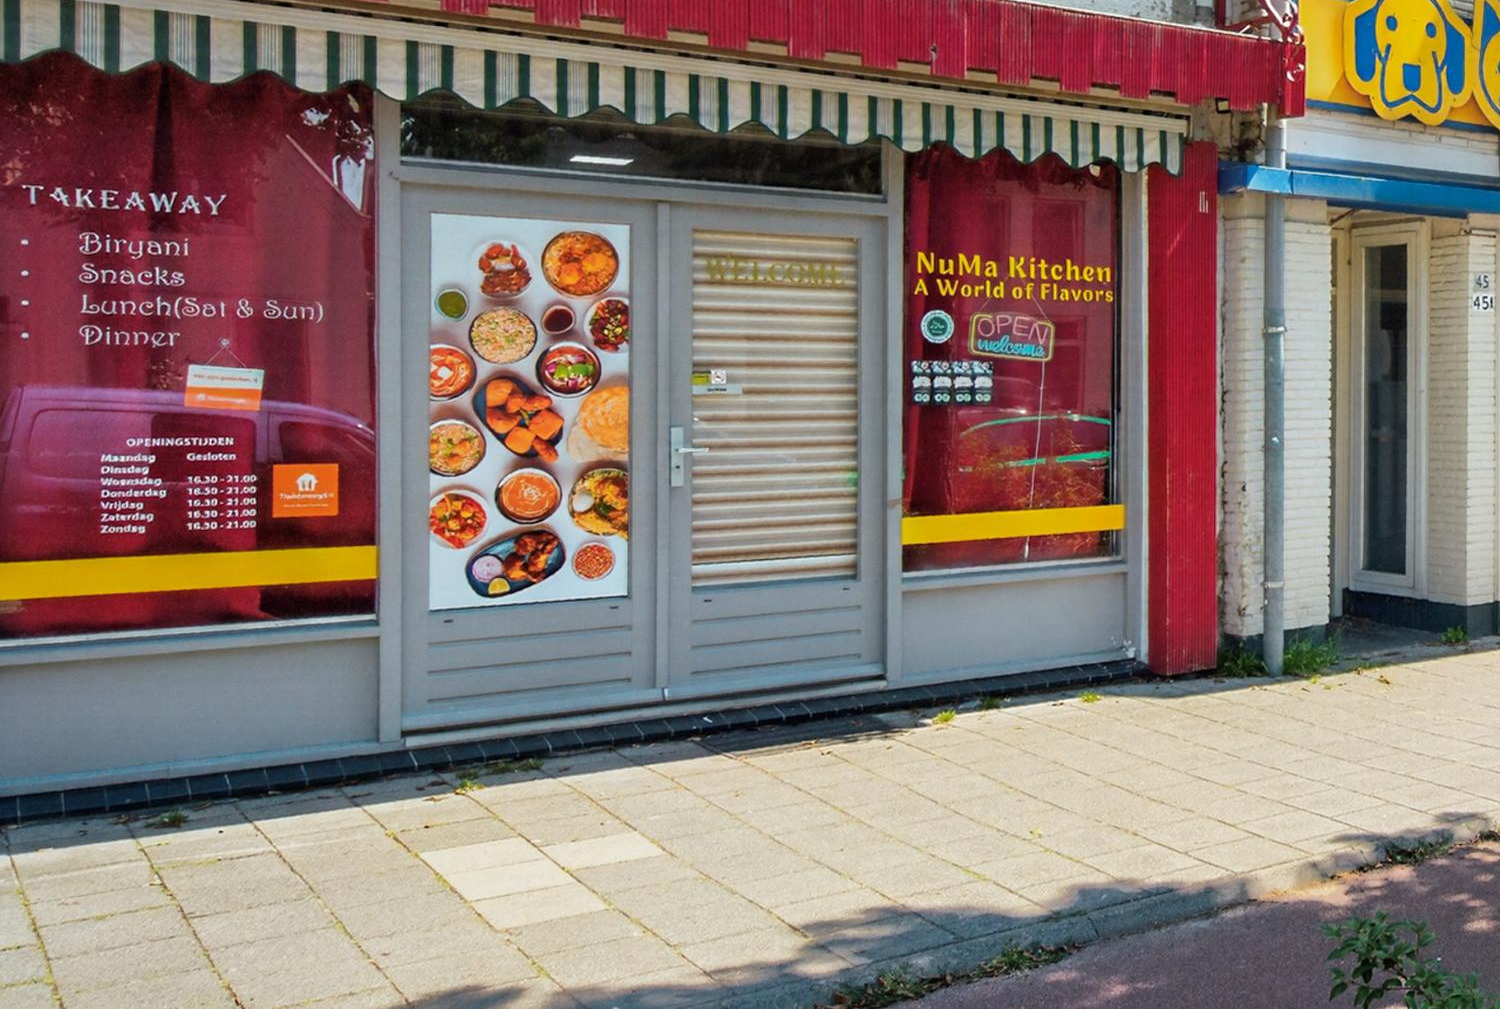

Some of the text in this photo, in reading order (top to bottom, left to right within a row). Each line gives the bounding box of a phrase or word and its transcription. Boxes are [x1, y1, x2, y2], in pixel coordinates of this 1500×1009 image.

[22, 185, 227, 216] TAKEAWAY
[79, 231, 190, 259] Biryani
[79, 263, 185, 287] Snacks
[706, 254, 844, 288] WELCOME
[917, 251, 1111, 283] NuMa Kitchen
[914, 279, 1114, 303] A World of Flavors
[1475, 274, 1490, 289] 45
[236, 298, 254, 319] &
[263, 299, 325, 323] Sun)
[79, 325, 181, 349] Dinner
[977, 315, 1049, 345] OPEN
[977, 335, 1046, 357] welcome
[126, 437, 234, 448] OPENINGSTIJDEN
[100, 452, 237, 463] Maandag Gesloten
[100, 465, 149, 475] Dinsdag
[100, 477, 163, 487] Woensdag
[100, 488, 167, 499] Donderdag
[100, 501, 145, 511] Vrijdag
[100, 513, 154, 523] Zaterdag
[100, 524, 146, 534] Zondag
